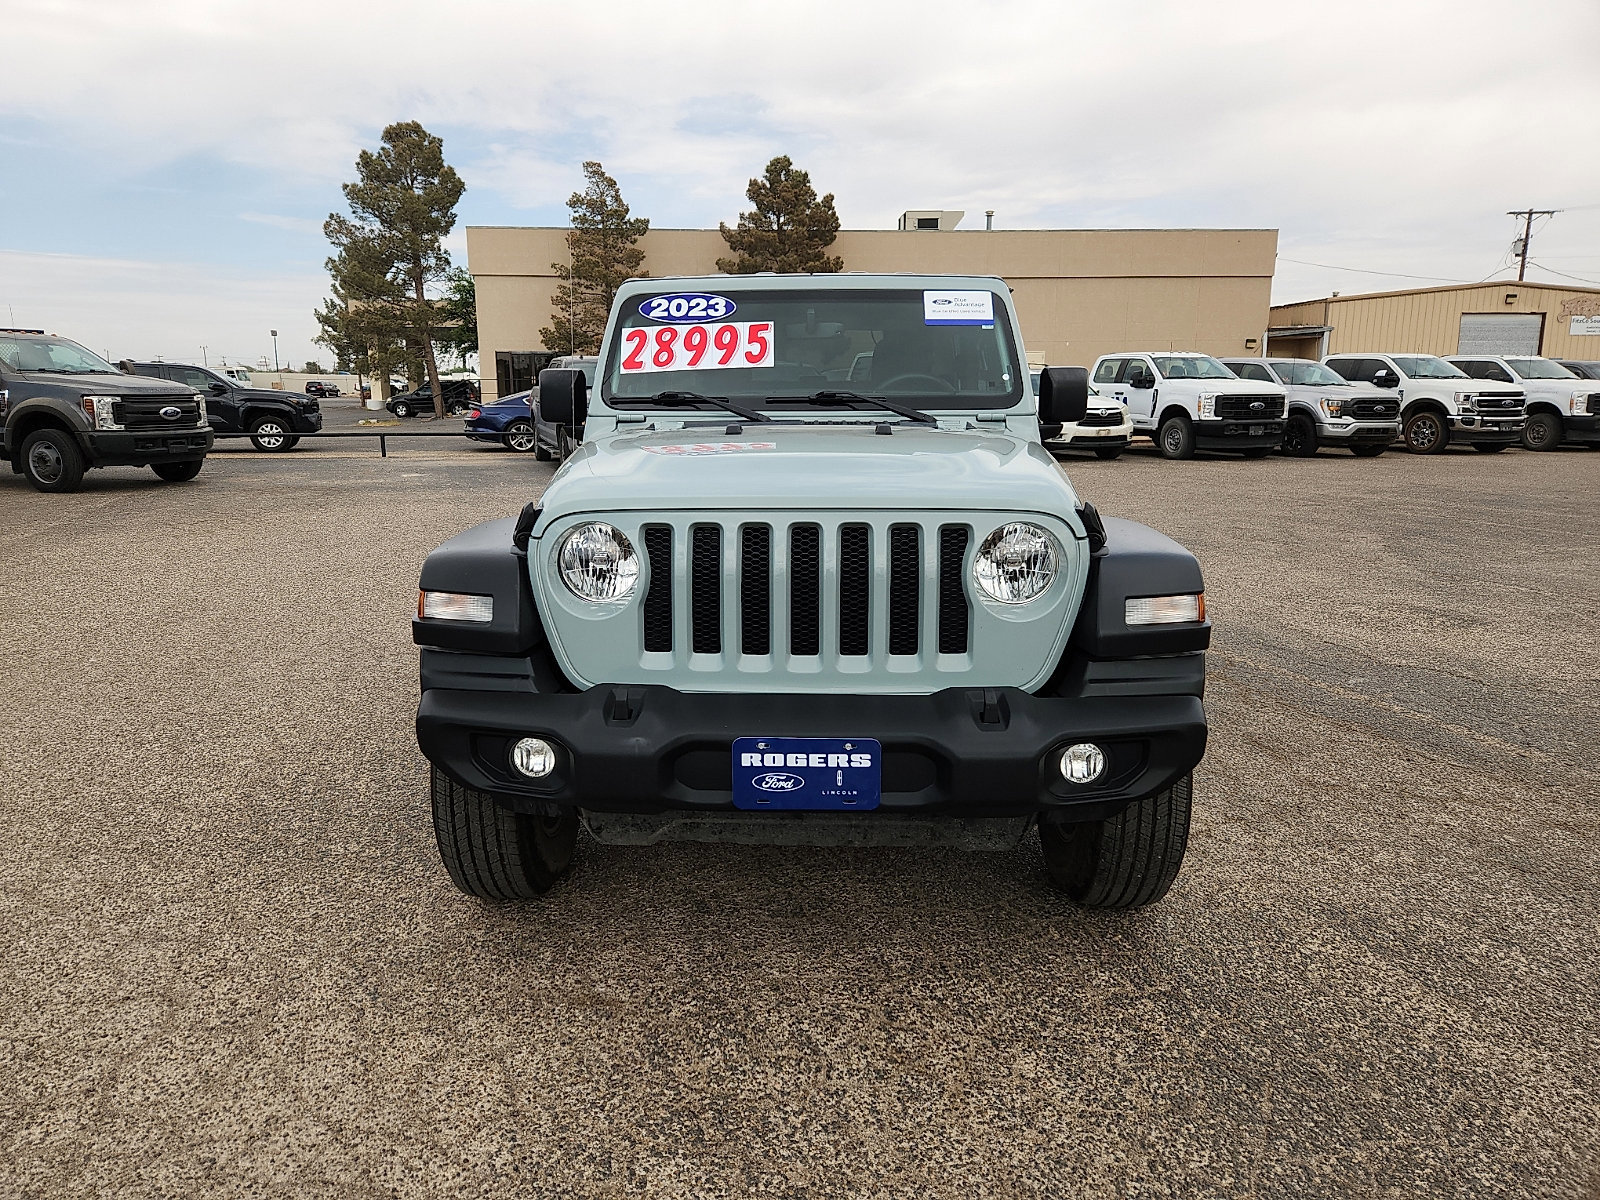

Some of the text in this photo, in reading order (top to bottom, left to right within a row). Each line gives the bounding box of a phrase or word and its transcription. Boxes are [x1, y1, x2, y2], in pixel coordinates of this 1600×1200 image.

[649, 298, 727, 318] 2023
[621, 323, 773, 371] 28995
[741, 752, 872, 768] ROGERS
[761, 774, 795, 790] Ford
